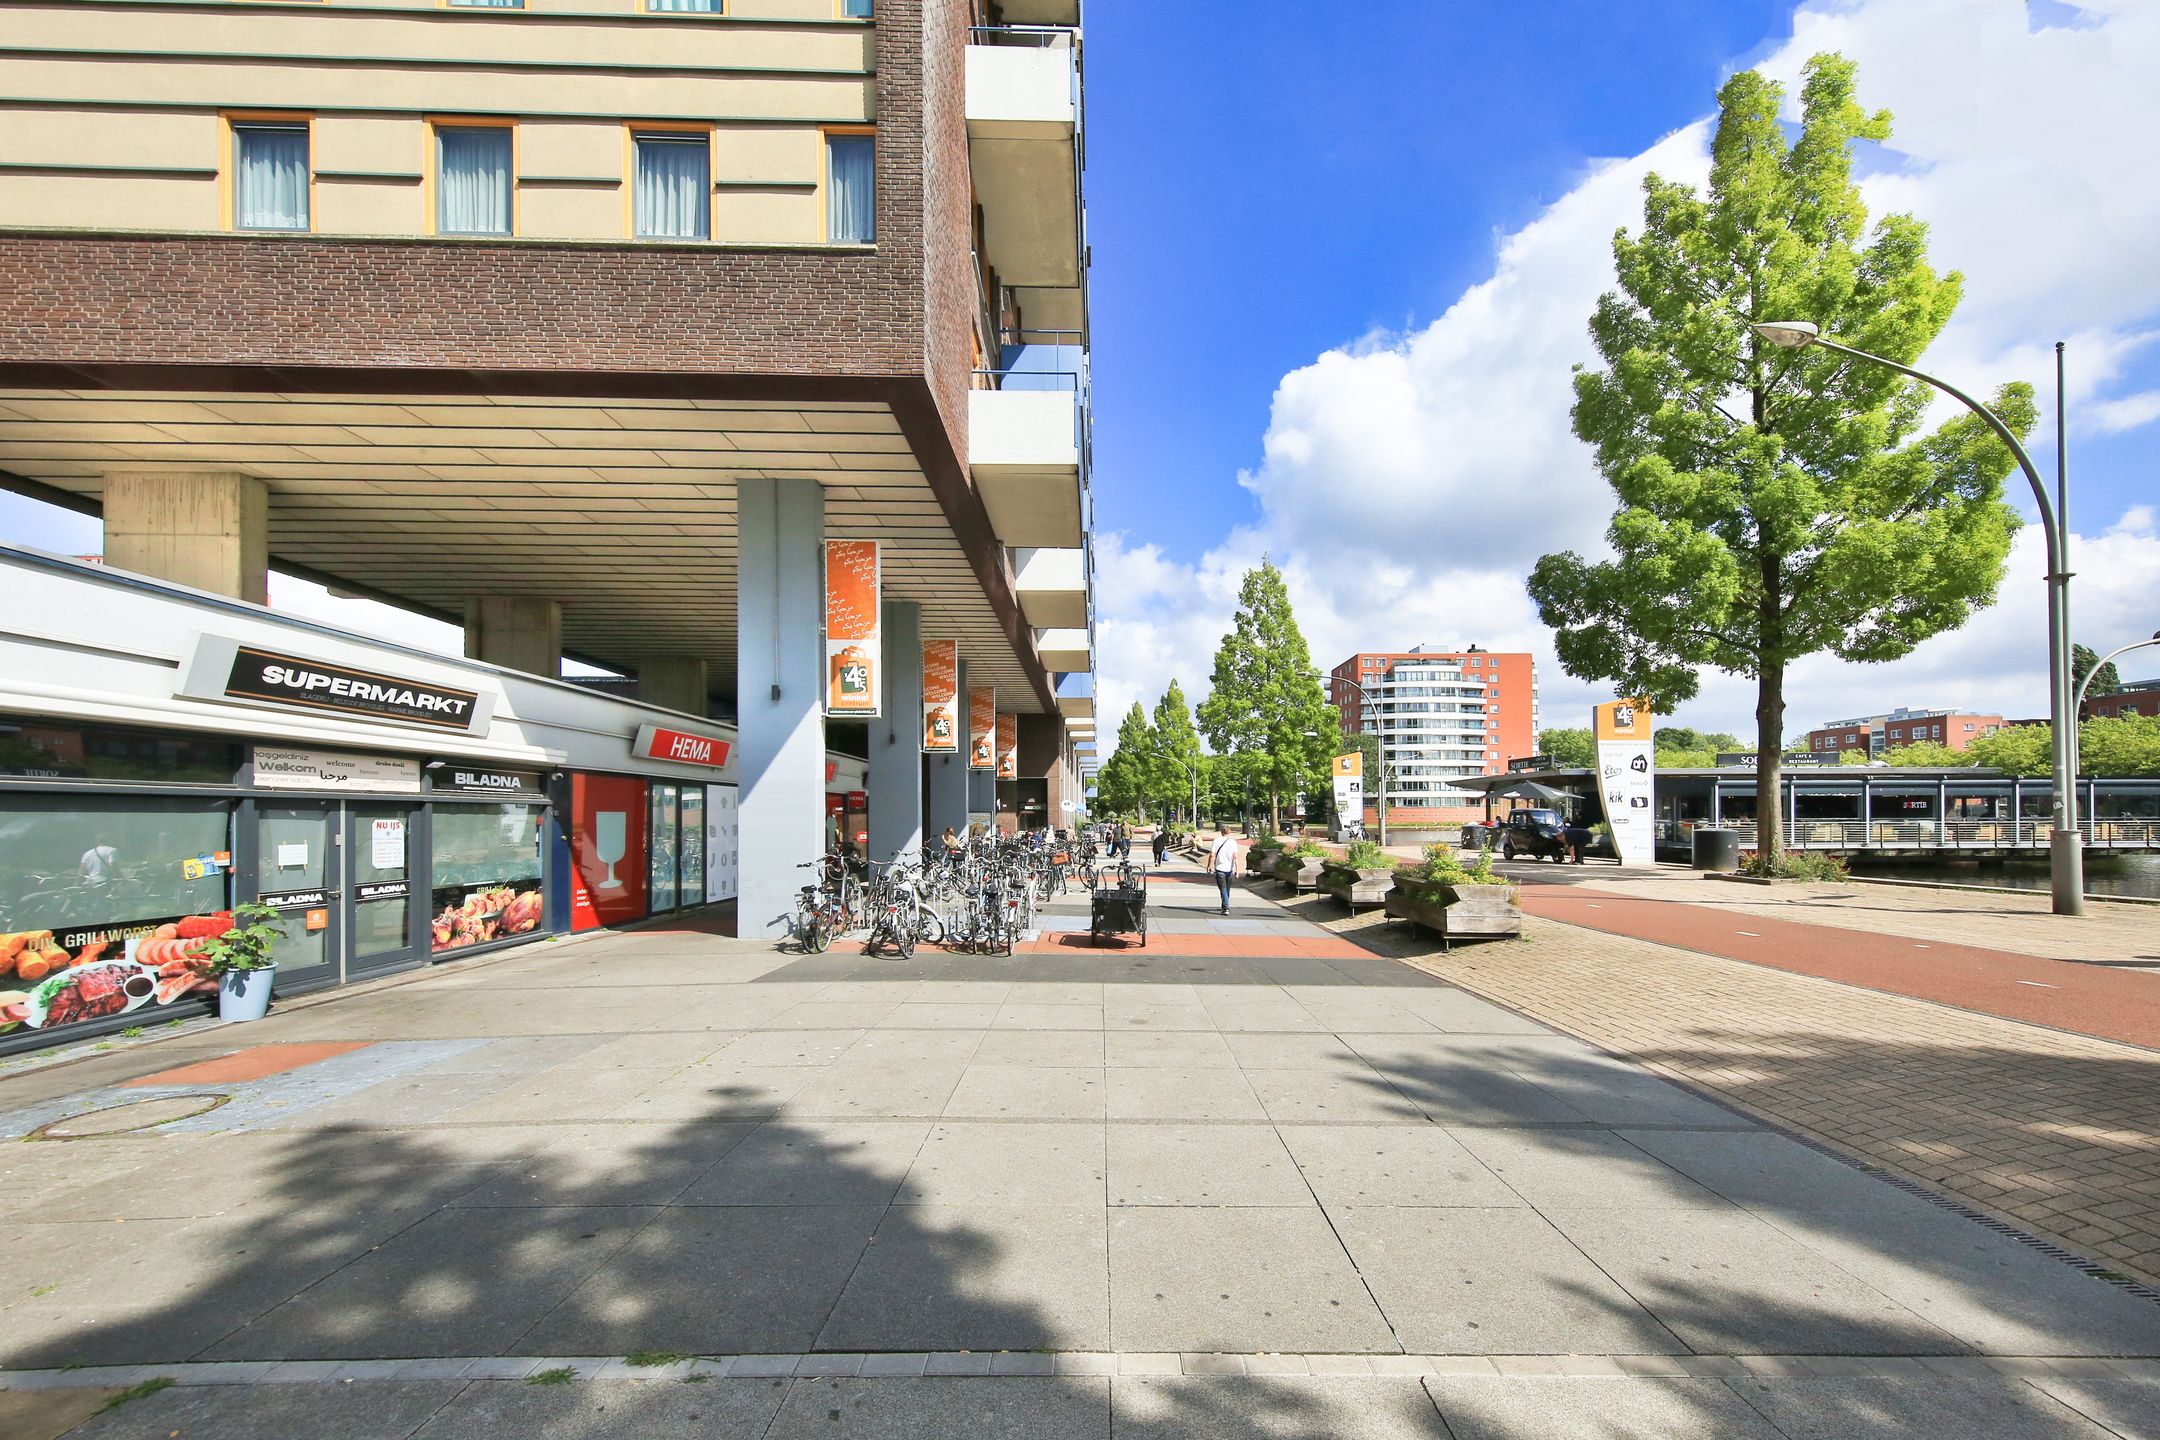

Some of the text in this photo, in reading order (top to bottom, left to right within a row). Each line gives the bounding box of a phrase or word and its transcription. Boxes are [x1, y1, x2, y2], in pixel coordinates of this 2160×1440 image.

[262, 665, 468, 714] SUPERMARKT
[670, 736, 712, 762] HEMA
[259, 761, 316, 774] Welkom
[326, 760, 356, 768] welcome
[1604, 764, 1623, 776] Etos
[320, 770, 348, 783] مرحبا
[455, 772, 521, 788] BILADNA
[1608, 791, 1623, 803] kik
[390, 822, 400, 831] IJS
[361, 884, 406, 896] BILADNA
[266, 893, 324, 906] BILADNA
[65, 925, 158, 948] GRILLWORST
